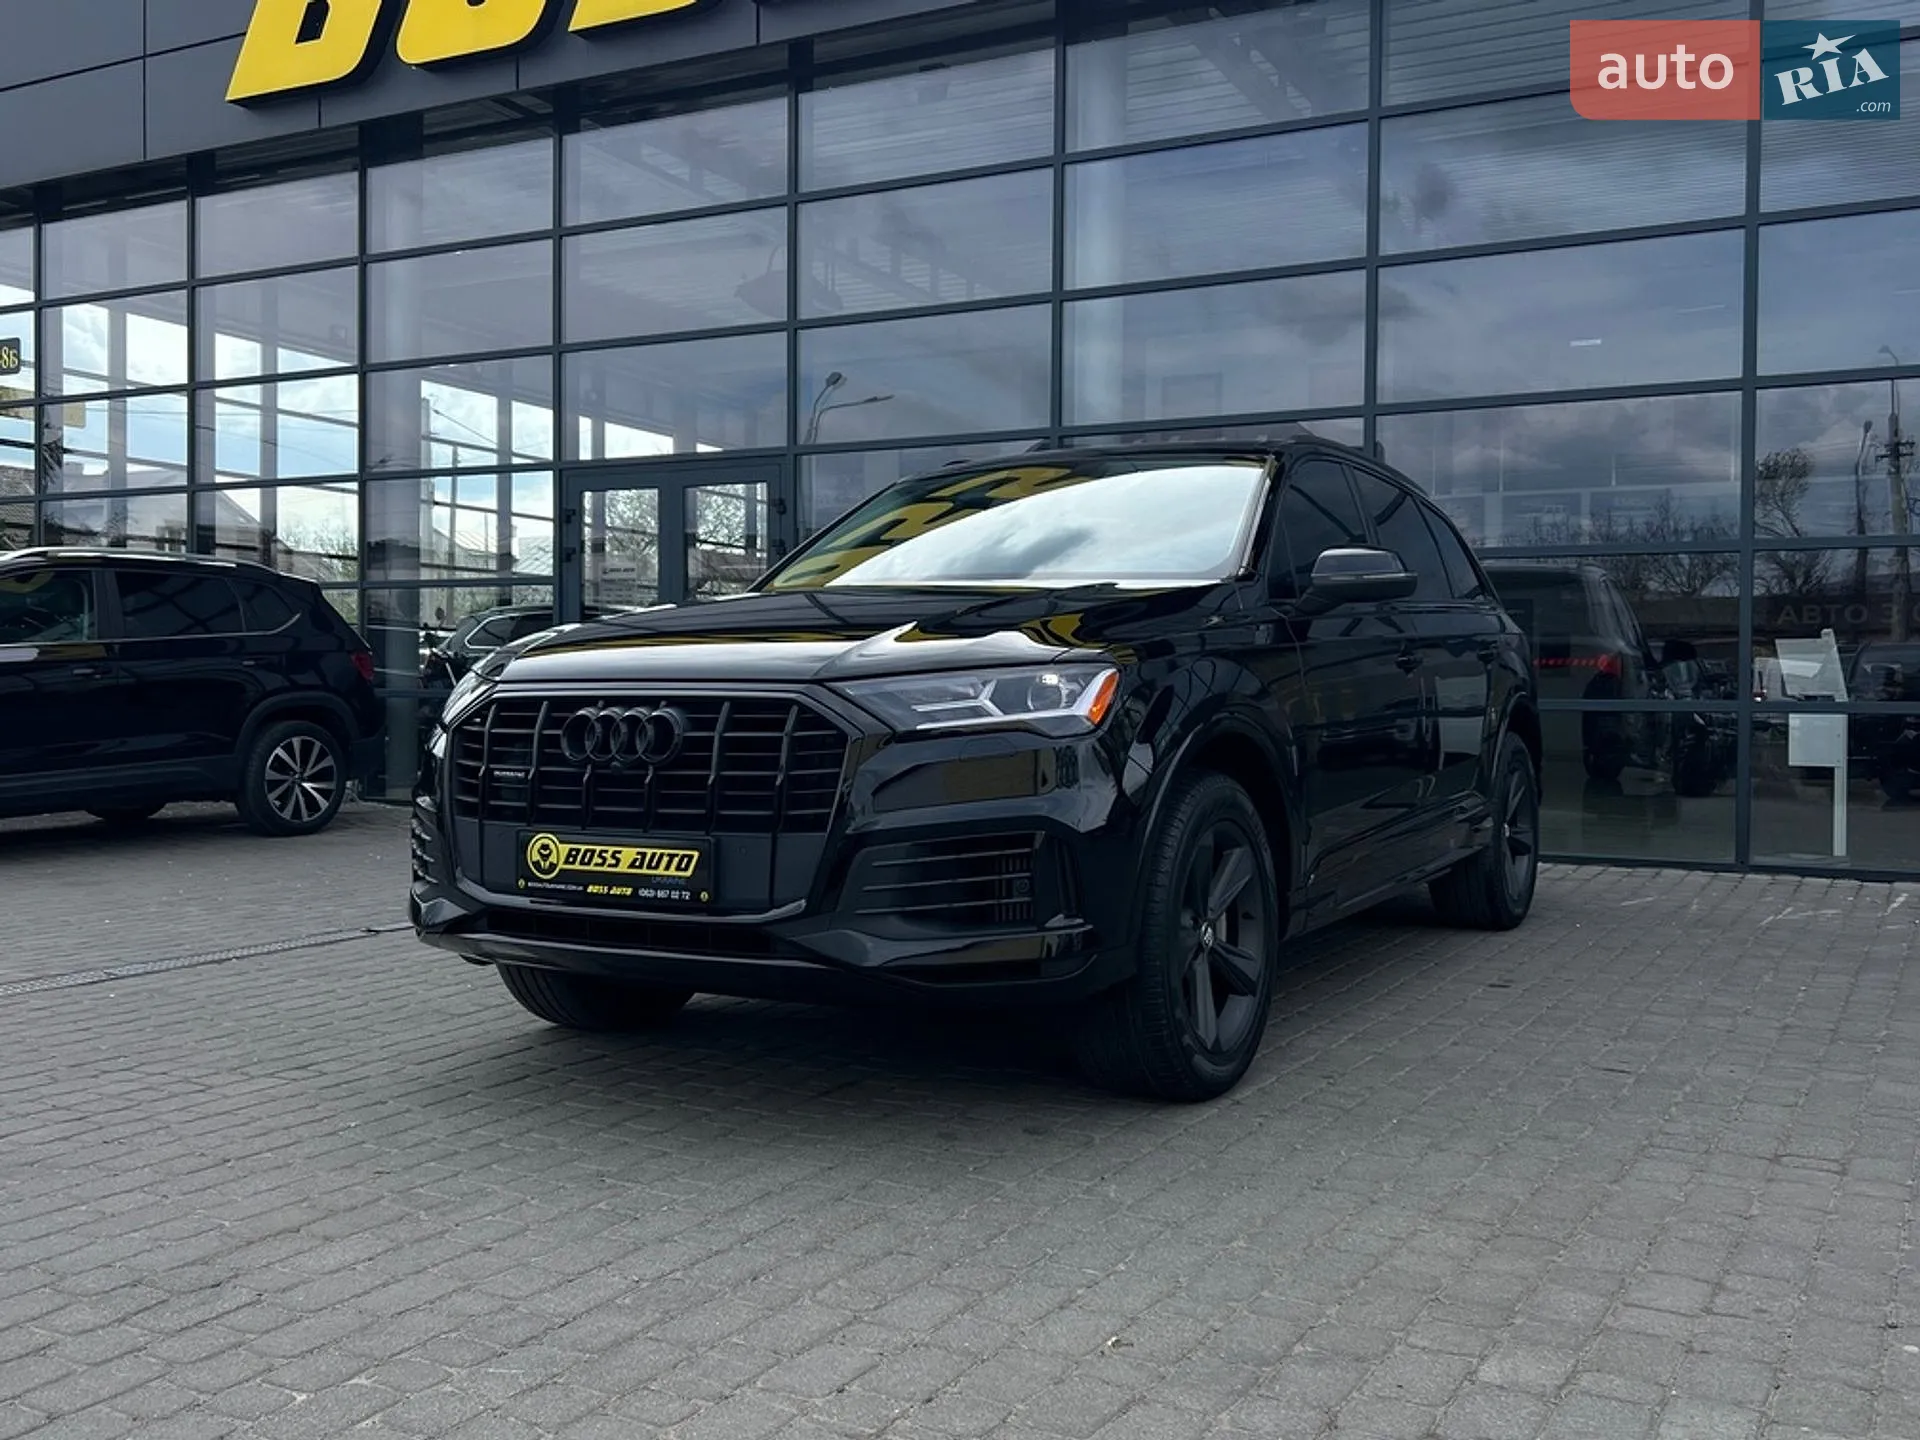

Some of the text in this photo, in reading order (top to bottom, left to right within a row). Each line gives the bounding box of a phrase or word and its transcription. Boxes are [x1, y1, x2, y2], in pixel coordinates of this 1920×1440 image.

[1777, 603, 1869, 625] АВТО
[563, 848, 695, 872] BOSS AUTO
